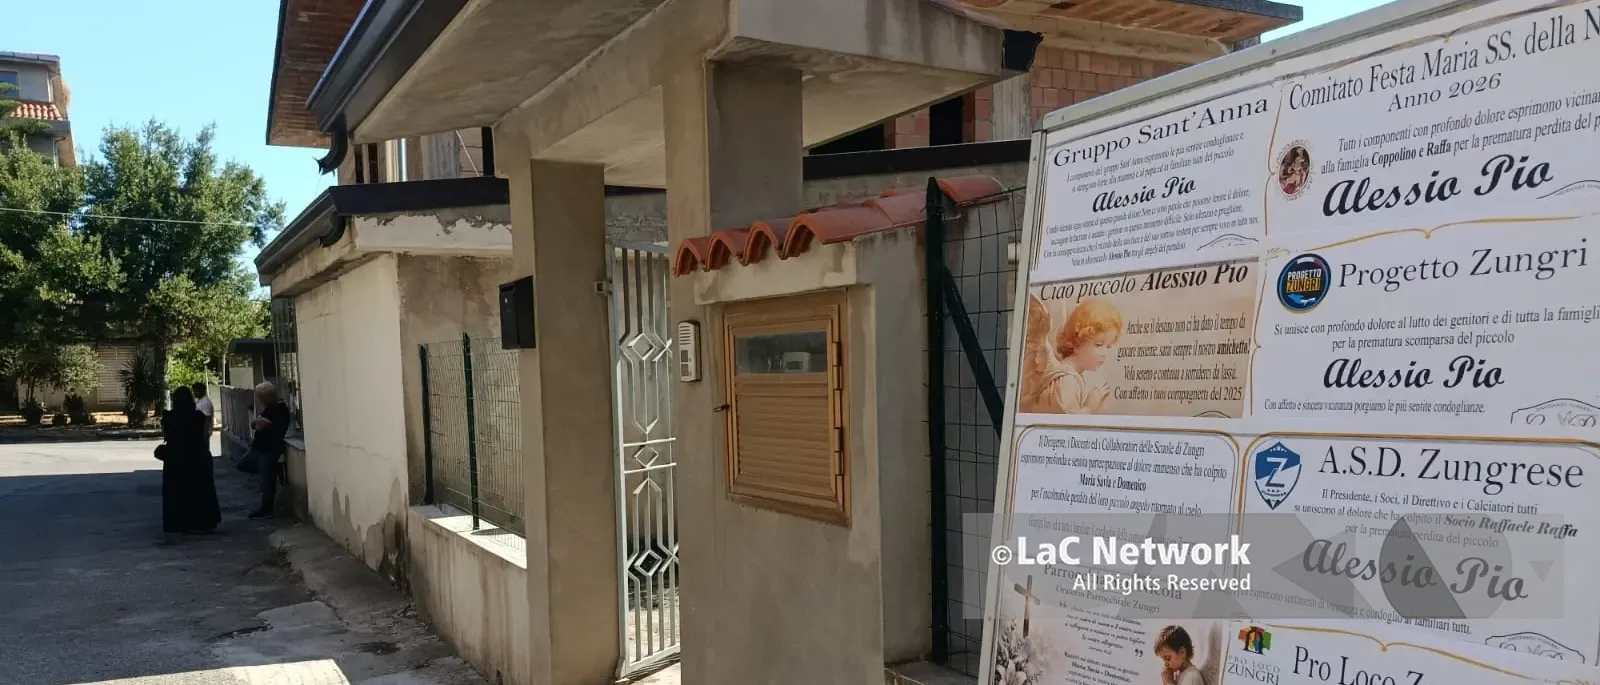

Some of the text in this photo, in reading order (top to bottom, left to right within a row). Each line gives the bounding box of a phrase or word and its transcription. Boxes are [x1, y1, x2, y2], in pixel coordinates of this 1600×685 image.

[1290, 75, 1363, 110] Comitato
[1369, 63, 1415, 92] Festa
[1421, 41, 1479, 80] Maria
[1485, 30, 1516, 64] SS.
[1524, 15, 1575, 55] della
[1388, 72, 1502, 112] Anno 2026
[1338, 136, 1356, 153] Tutti
[1363, 124, 1411, 148] componenti
[1413, 125, 1429, 138] con
[1430, 114, 1472, 138] profondo
[1474, 109, 1505, 126] dolore
[1508, 99, 1562, 122] esprimono
[1054, 136, 1131, 167] Gruppo
[1321, 160, 1335, 175] alla
[1337, 155, 1369, 173] famiglia
[1371, 146, 1416, 169] Coppolino
[1418, 149, 1424, 158] e
[1426, 139, 1451, 156] Raffa
[1453, 139, 1468, 156] per
[1471, 133, 1480, 149] la
[1482, 127, 1531, 151] prematura
[1534, 117, 1571, 141] perdita
[1574, 113, 1591, 130] del
[1092, 186, 1156, 213] Alessio
[1162, 176, 1196, 199] Pio
[1322, 154, 1554, 217] Alessio Pio
[1287, 268, 1322, 280] PROGETTO
[1338, 238, 1588, 293] Progetto Zungri
[1040, 264, 1248, 303] Ciao piccolo Alessio Pio
[1286, 278, 1321, 292] ZUNGRI
[1220, 316, 1238, 334] tempo
[1274, 323, 1282, 335] Si
[1284, 324, 1311, 335] unisce
[1311, 324, 1325, 333] con
[1327, 319, 1365, 335] profondo
[1368, 317, 1396, 331] dolore
[1398, 317, 1407, 329] al
[1409, 315, 1430, 329] lutto
[1433, 313, 1447, 327] dei
[1450, 311, 1489, 329] genitori
[1492, 314, 1499, 324] e
[1501, 310, 1512, 324] di
[1515, 311, 1540, 323] tutta
[1543, 308, 1553, 322] la
[1217, 338, 1251, 355] amichetto!
[1332, 330, 1514, 352] per la prematura scomparsa del piccolo
[1323, 355, 1505, 388] Alessio Pio
[1114, 386, 1127, 400] Con
[1210, 386, 1221, 400] del
[1223, 386, 1243, 401] 2025
[1354, 400, 1386, 414] porgiamo
[1387, 399, 1394, 411] le
[1433, 401, 1485, 416] condoglianze.
[1091, 437, 1098, 450] ed
[1140, 439, 1153, 453] delle
[1154, 440, 1175, 455] Scuole
[1176, 440, 1181, 455] di
[1182, 442, 1205, 460] Zungri
[1080, 473, 1095, 487] Maria
[1117, 477, 1146, 491] Domenico
[1318, 445, 1583, 495] A.S.D. Zungrese
[1322, 489, 1329, 499] Il
[1330, 489, 1371, 502] Presidente,
[1380, 492, 1400, 505] Soci,
[1402, 493, 1409, 504] il
[1411, 494, 1450, 509] Direttivo
[1453, 501, 1459, 509] e
[1466, 499, 1514, 514] Calciatori
[1517, 503, 1538, 516] tutti
[1302, 504, 1336, 515] uniscono
[1337, 506, 1345, 516] al
[1347, 507, 1372, 519] dolore
[1374, 509, 1388, 520] che
[1402, 513, 1432, 526] colpito
[1434, 514, 1441, 525] il
[1443, 514, 1475, 527] Socio
[1479, 517, 1535, 534] Raffaele
[1537, 521, 1578, 540] Raffa
[1345, 523, 1357, 535] per
[1359, 523, 1367, 534] la
[1413, 529, 1443, 544] perdita
[1446, 533, 1460, 545] del
[1463, 536, 1498, 549] piccolo
[1303, 539, 1528, 601] Alessio Pio
[1086, 590, 1131, 607] Parrocchiale
[1133, 599, 1160, 614] Zungri
[1414, 615, 1450, 631] familiari
[1452, 620, 1472, 635] tutti.
[1293, 645, 1331, 681] Pro
